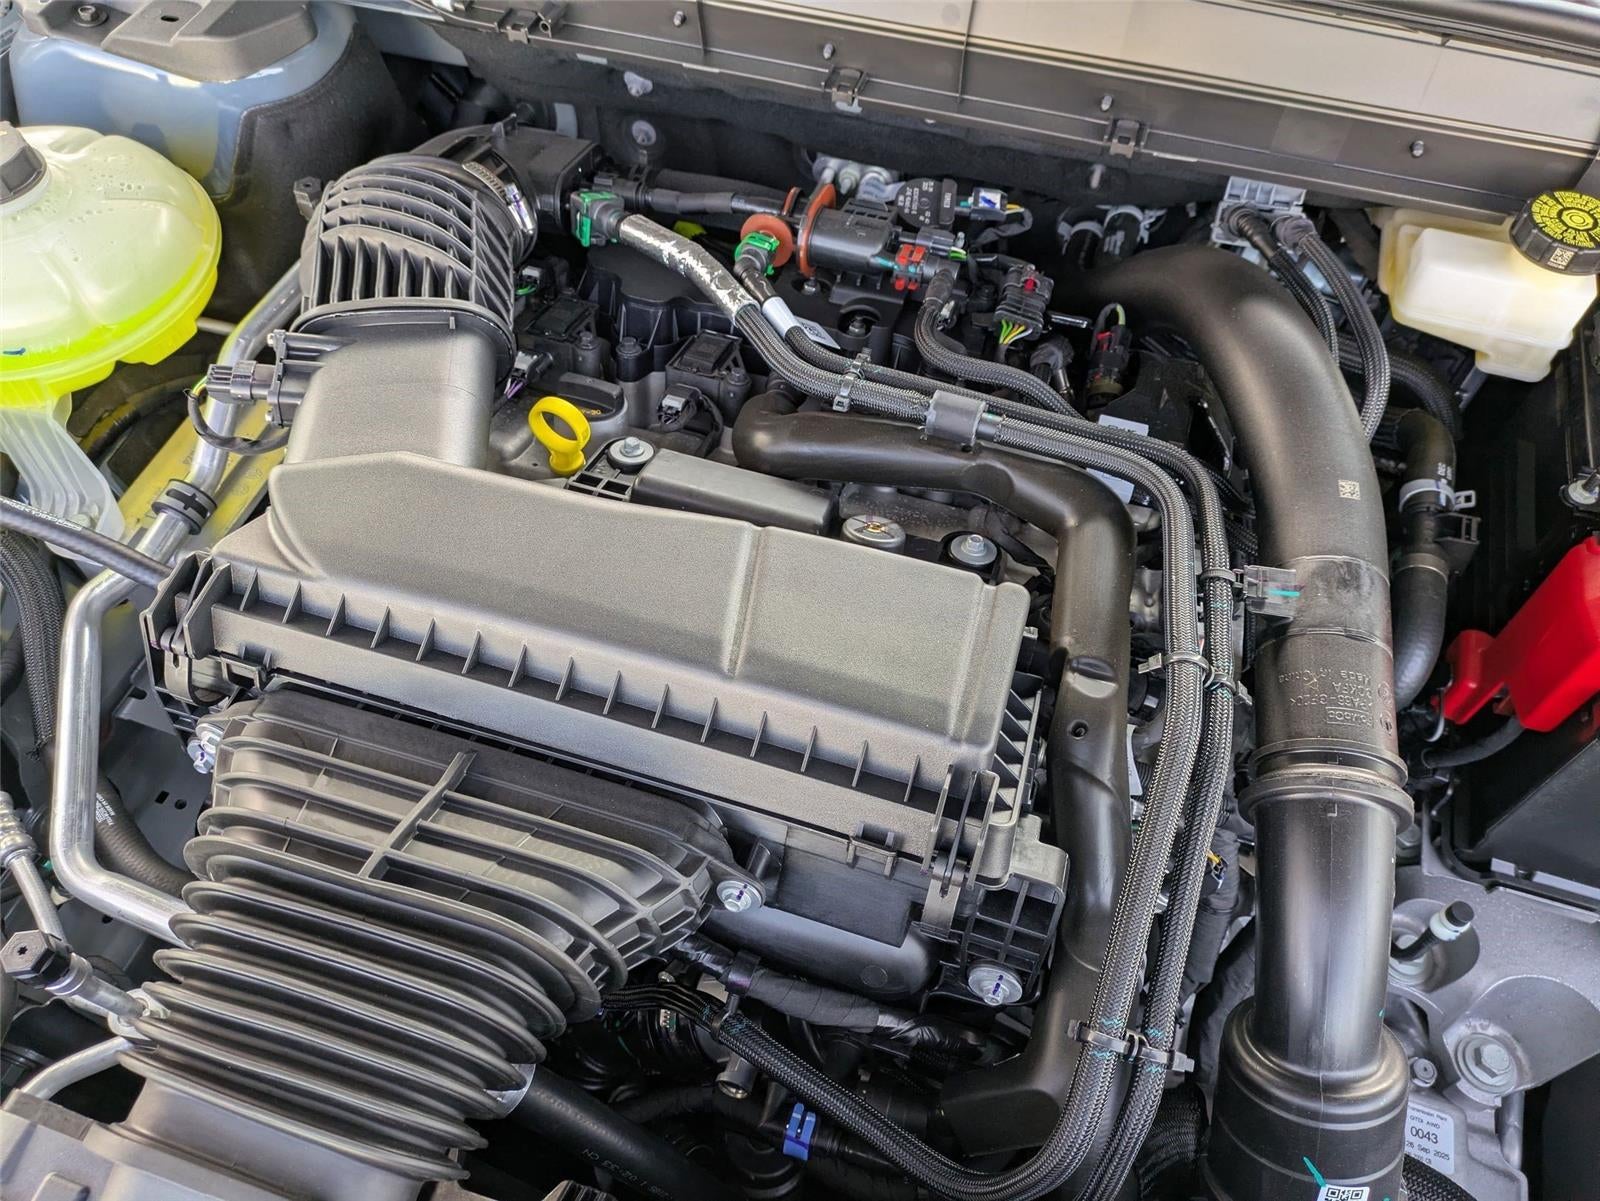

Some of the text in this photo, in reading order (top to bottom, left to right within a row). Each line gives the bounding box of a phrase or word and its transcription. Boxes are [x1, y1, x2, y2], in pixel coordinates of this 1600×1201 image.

[1410, 1126, 1439, 1145] 0043
[1417, 1143, 1431, 1154] Sep
[1433, 1149, 1451, 1161] 2025
